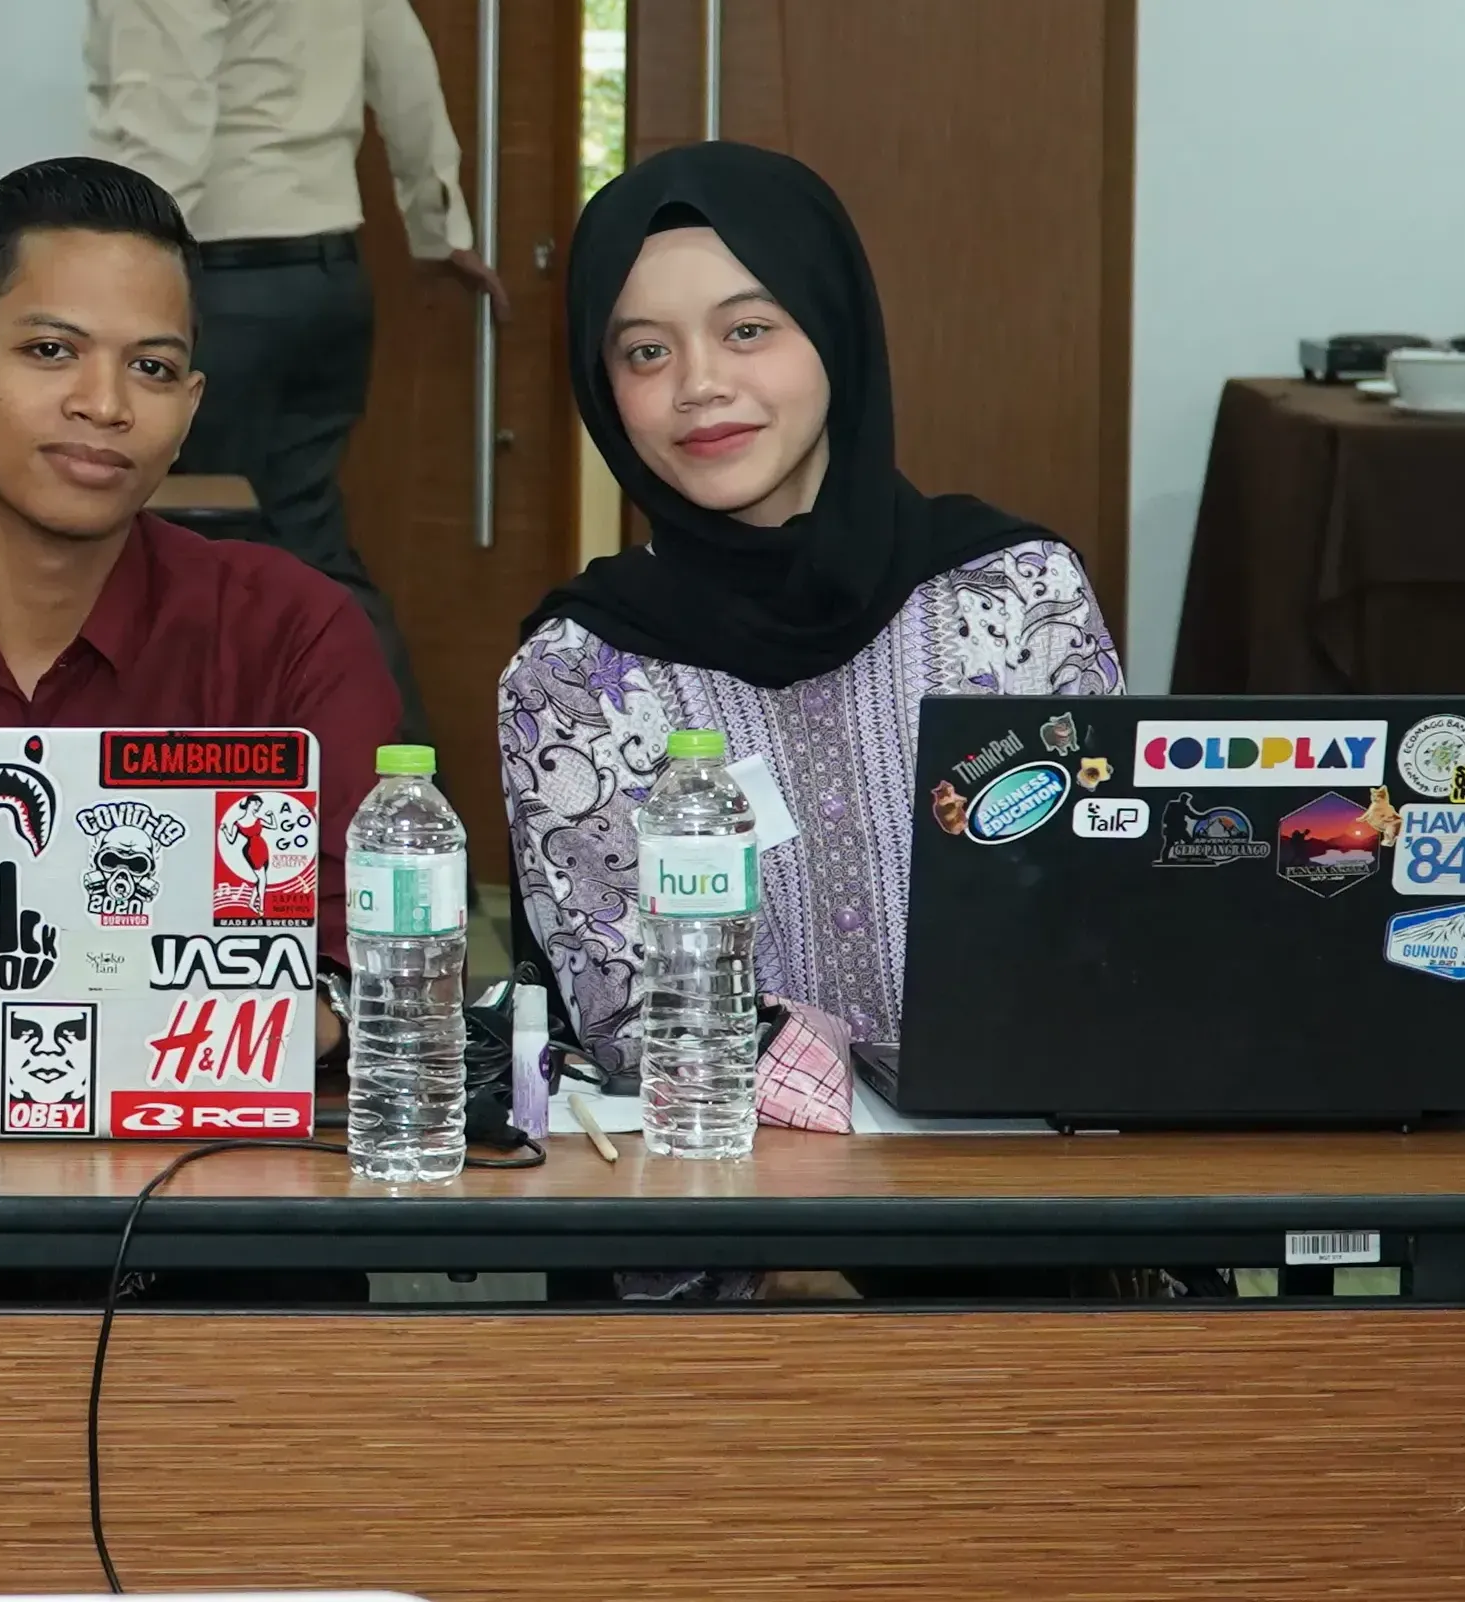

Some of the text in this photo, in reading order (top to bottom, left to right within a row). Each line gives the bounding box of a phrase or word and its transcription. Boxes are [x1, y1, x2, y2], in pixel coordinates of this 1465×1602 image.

[122, 742, 287, 775] CAMBRIDGE
[951, 730, 1024, 785] ThinkPad
[1144, 737, 1377, 769] COLDPLAY
[279, 801, 292, 814] A
[976, 772, 1052, 823] BUSINESS
[981, 780, 1064, 838] EDUCATION
[76, 802, 186, 847] COVID-19
[280, 814, 312, 833] GO
[275, 834, 309, 851] GO
[660, 858, 729, 895] hura
[88, 896, 143, 914] 2020
[102, 915, 149, 926] SURVIVOR
[219, 918, 247, 926] MADE
[266, 918, 308, 926] SWEDEN
[1403, 944, 1458, 958] GUNUNG
[150, 998, 291, 1084] H&M
[10, 1103, 83, 1128] OBEY
[192, 1107, 300, 1127] RCB
